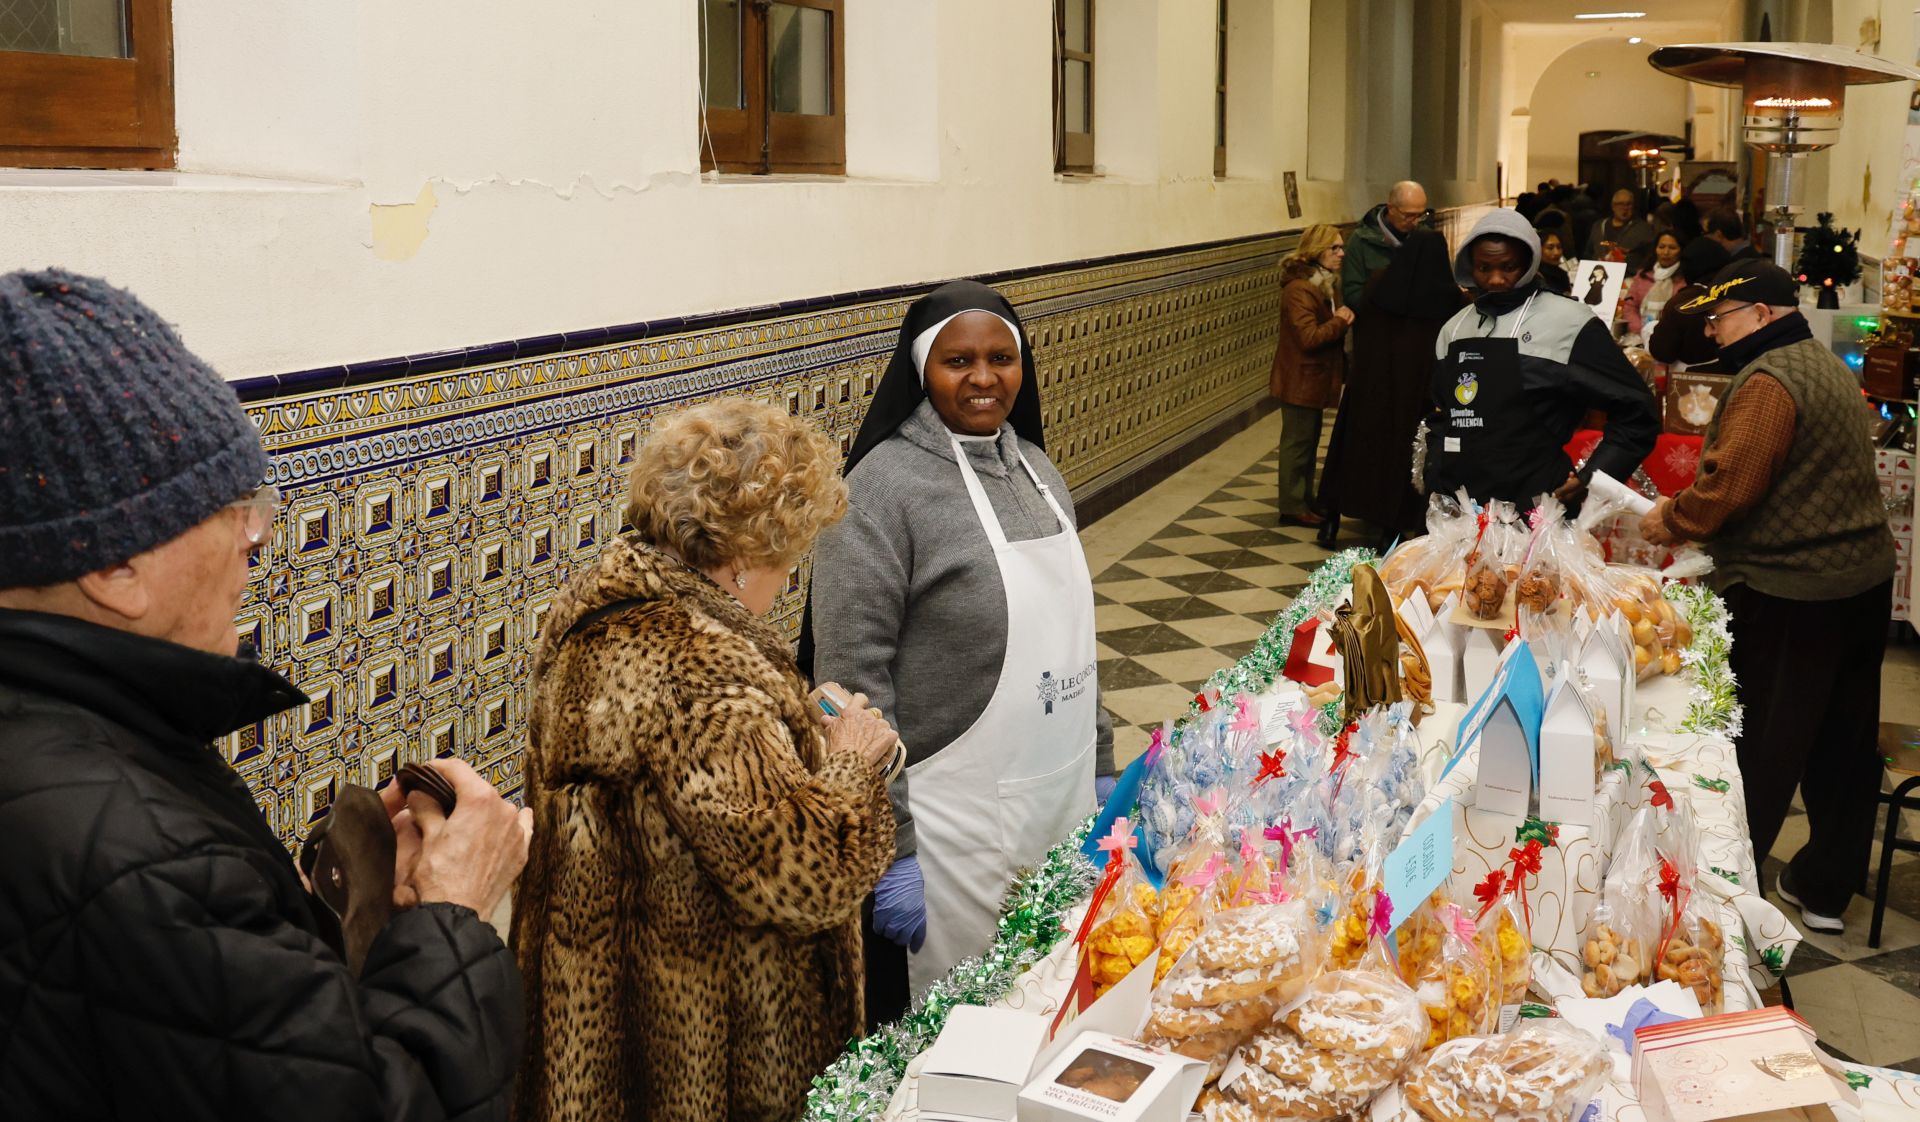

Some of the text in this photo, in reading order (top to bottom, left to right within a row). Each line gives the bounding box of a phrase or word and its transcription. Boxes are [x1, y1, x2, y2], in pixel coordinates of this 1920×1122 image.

[1456, 417, 1484, 428] PALENCIA
[1061, 677, 1076, 691] LE
[1046, 1085, 1121, 1112] MONASTERIO DE
